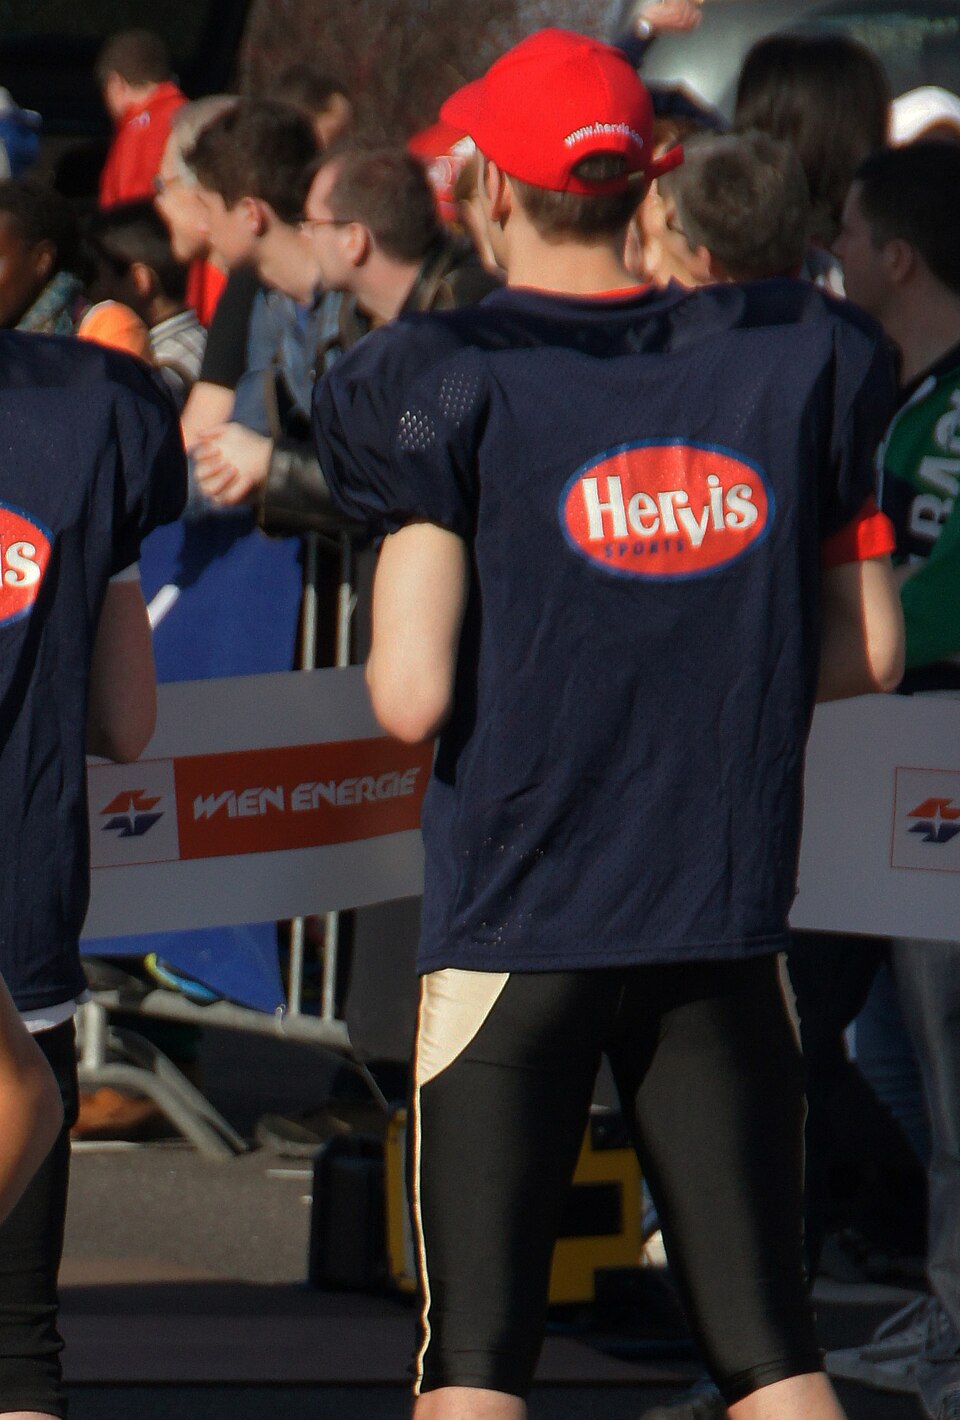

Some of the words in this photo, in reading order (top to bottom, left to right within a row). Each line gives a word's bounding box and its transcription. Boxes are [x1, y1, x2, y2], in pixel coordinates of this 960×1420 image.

[582, 473, 759, 548] Hervis
[604, 540, 685, 558] SPORTS
[193, 785, 285, 821] WIEN
[291, 767, 421, 812] ENERGIE
